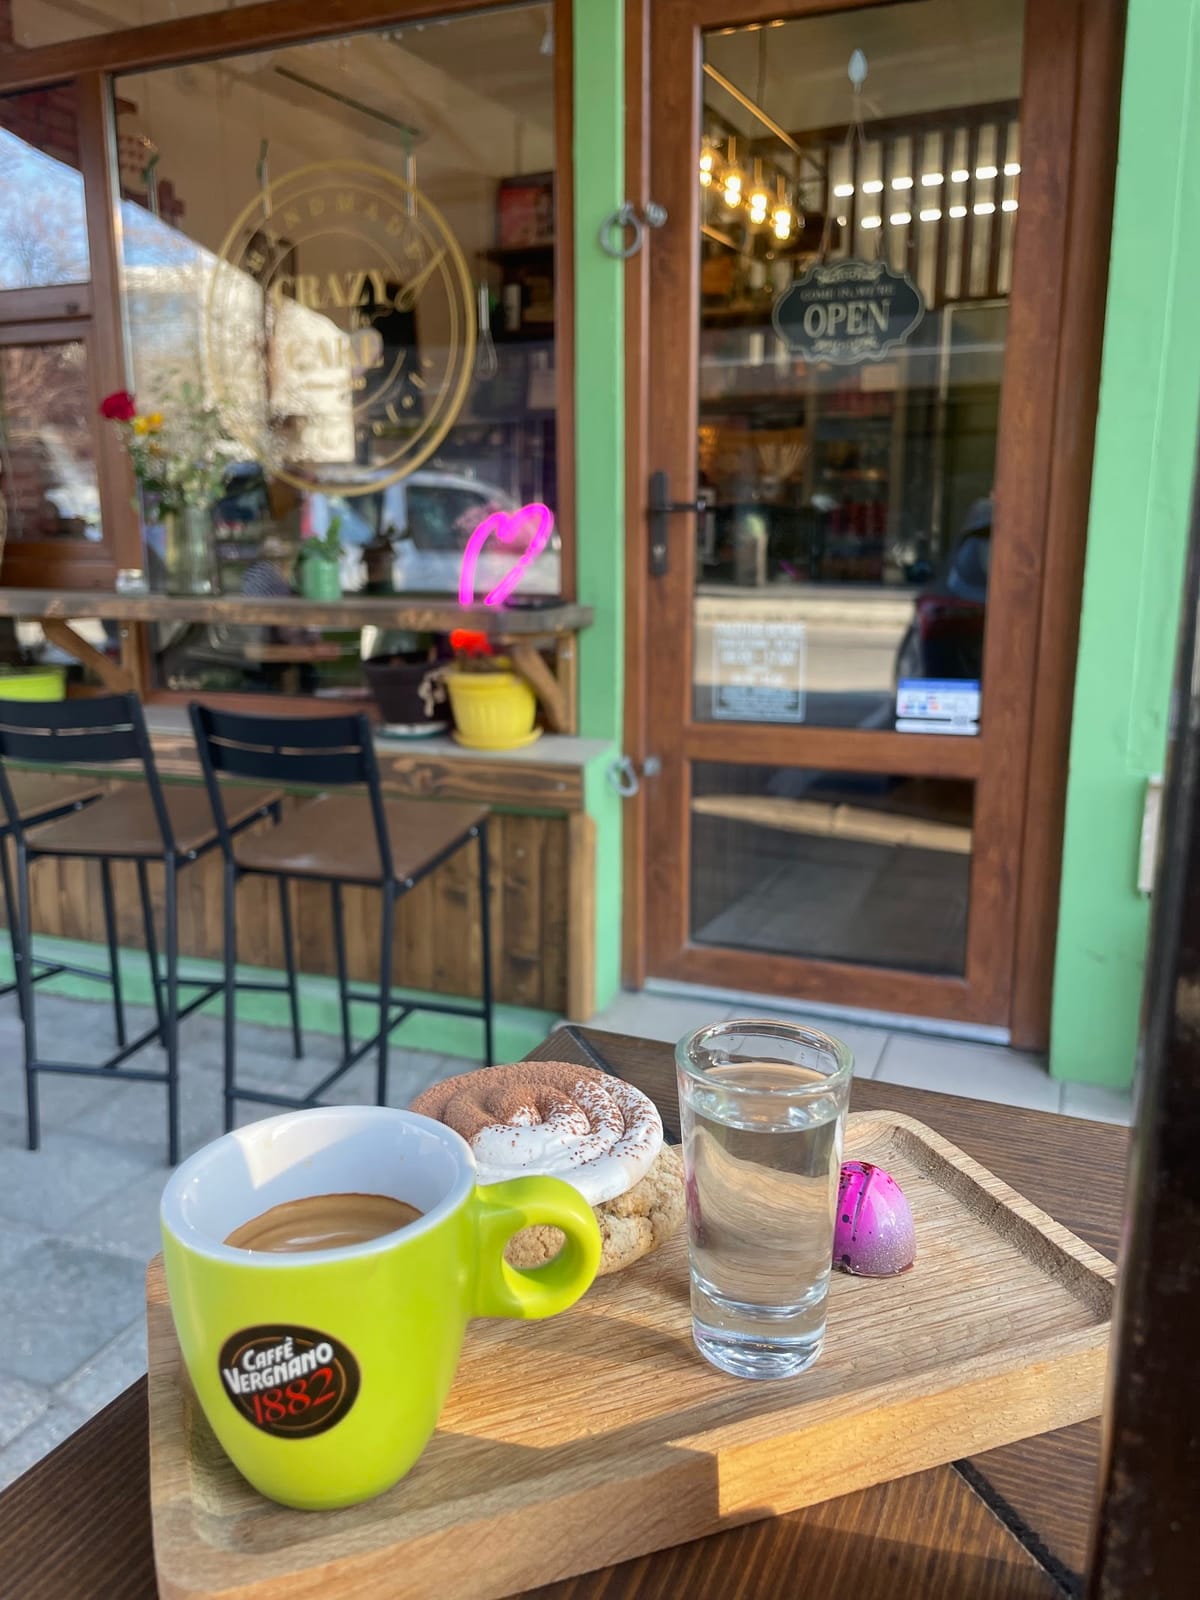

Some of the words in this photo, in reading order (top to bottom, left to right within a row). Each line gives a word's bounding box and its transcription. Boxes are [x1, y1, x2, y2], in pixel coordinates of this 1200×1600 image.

[271, 268, 391, 310] CRAZY
[803, 299, 890, 338] OPEN
[223, 1342, 333, 1394] VERGNANO
[252, 1367, 336, 1425] 1882
